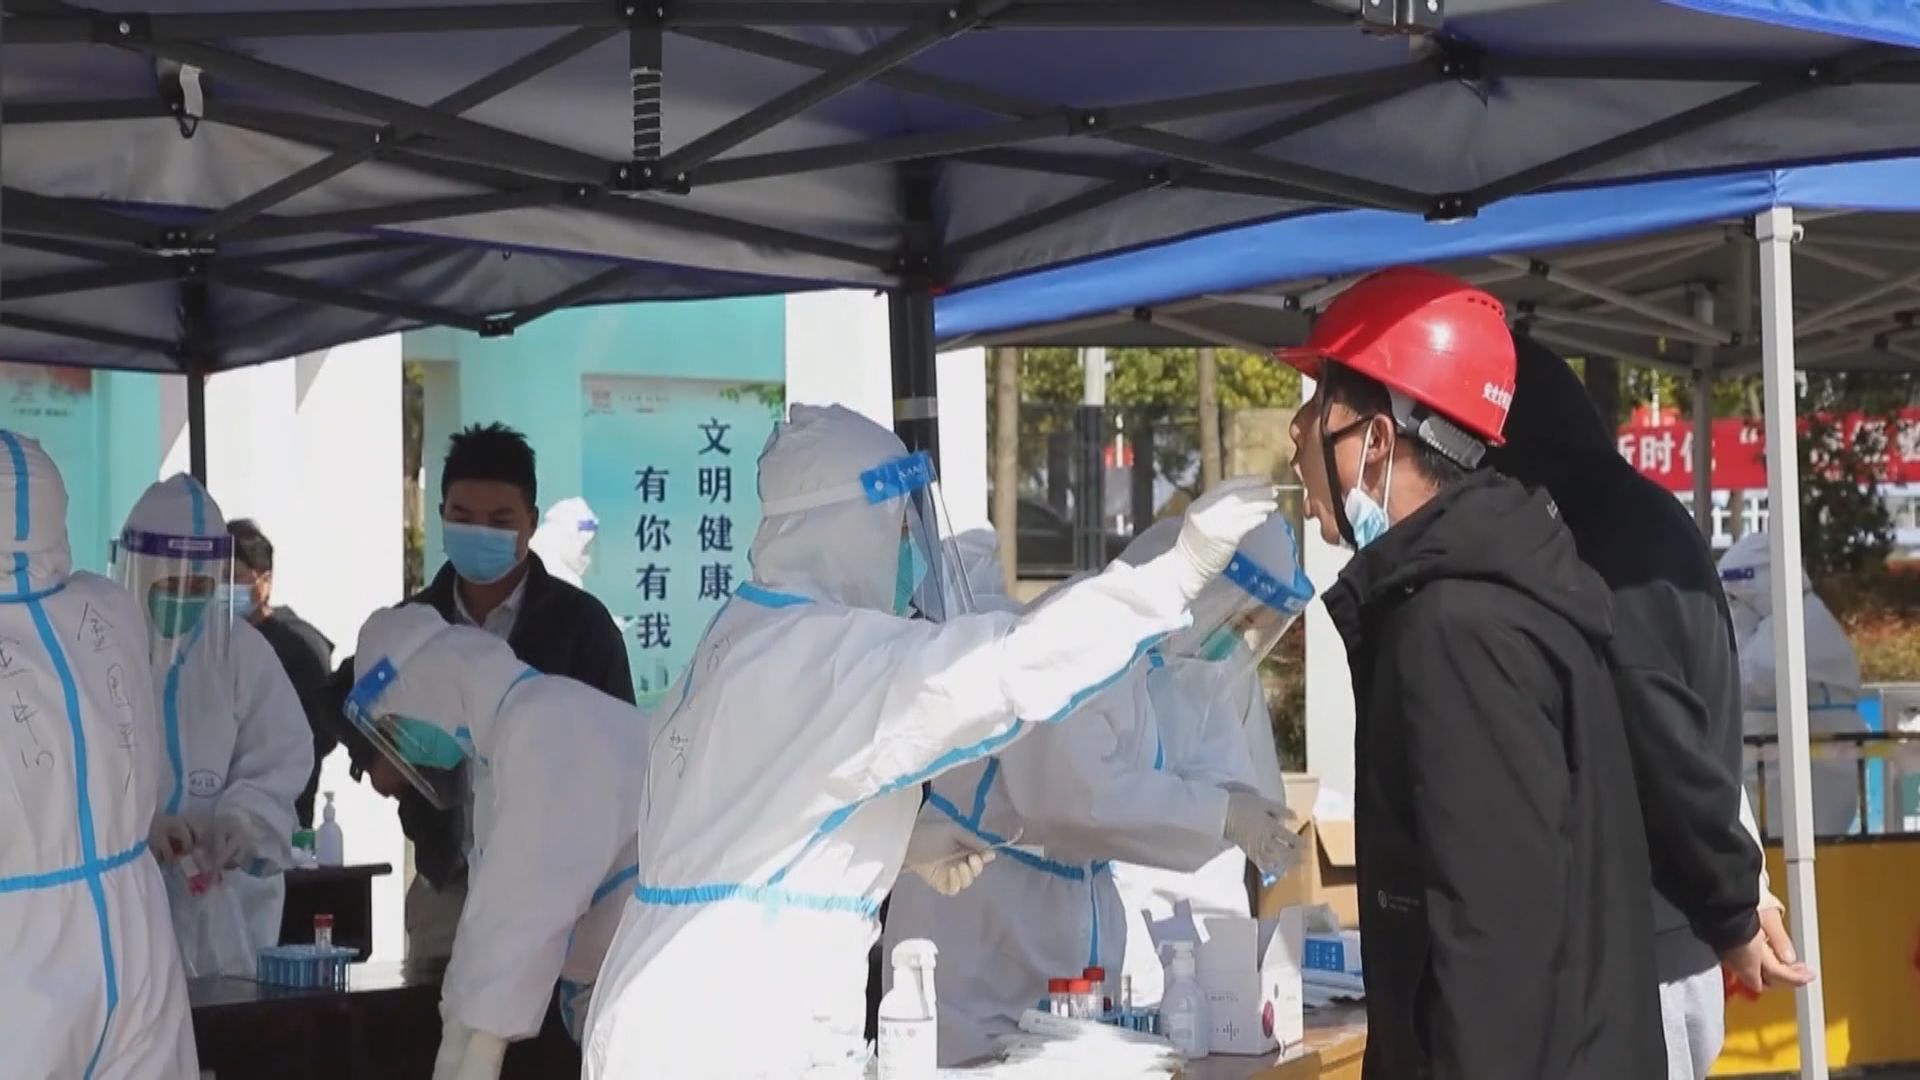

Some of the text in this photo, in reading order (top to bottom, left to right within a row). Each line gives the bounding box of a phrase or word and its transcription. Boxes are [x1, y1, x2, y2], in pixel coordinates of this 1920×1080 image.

[634, 465, 672, 650] 有你有我
[698, 416, 734, 601] 文明健康
